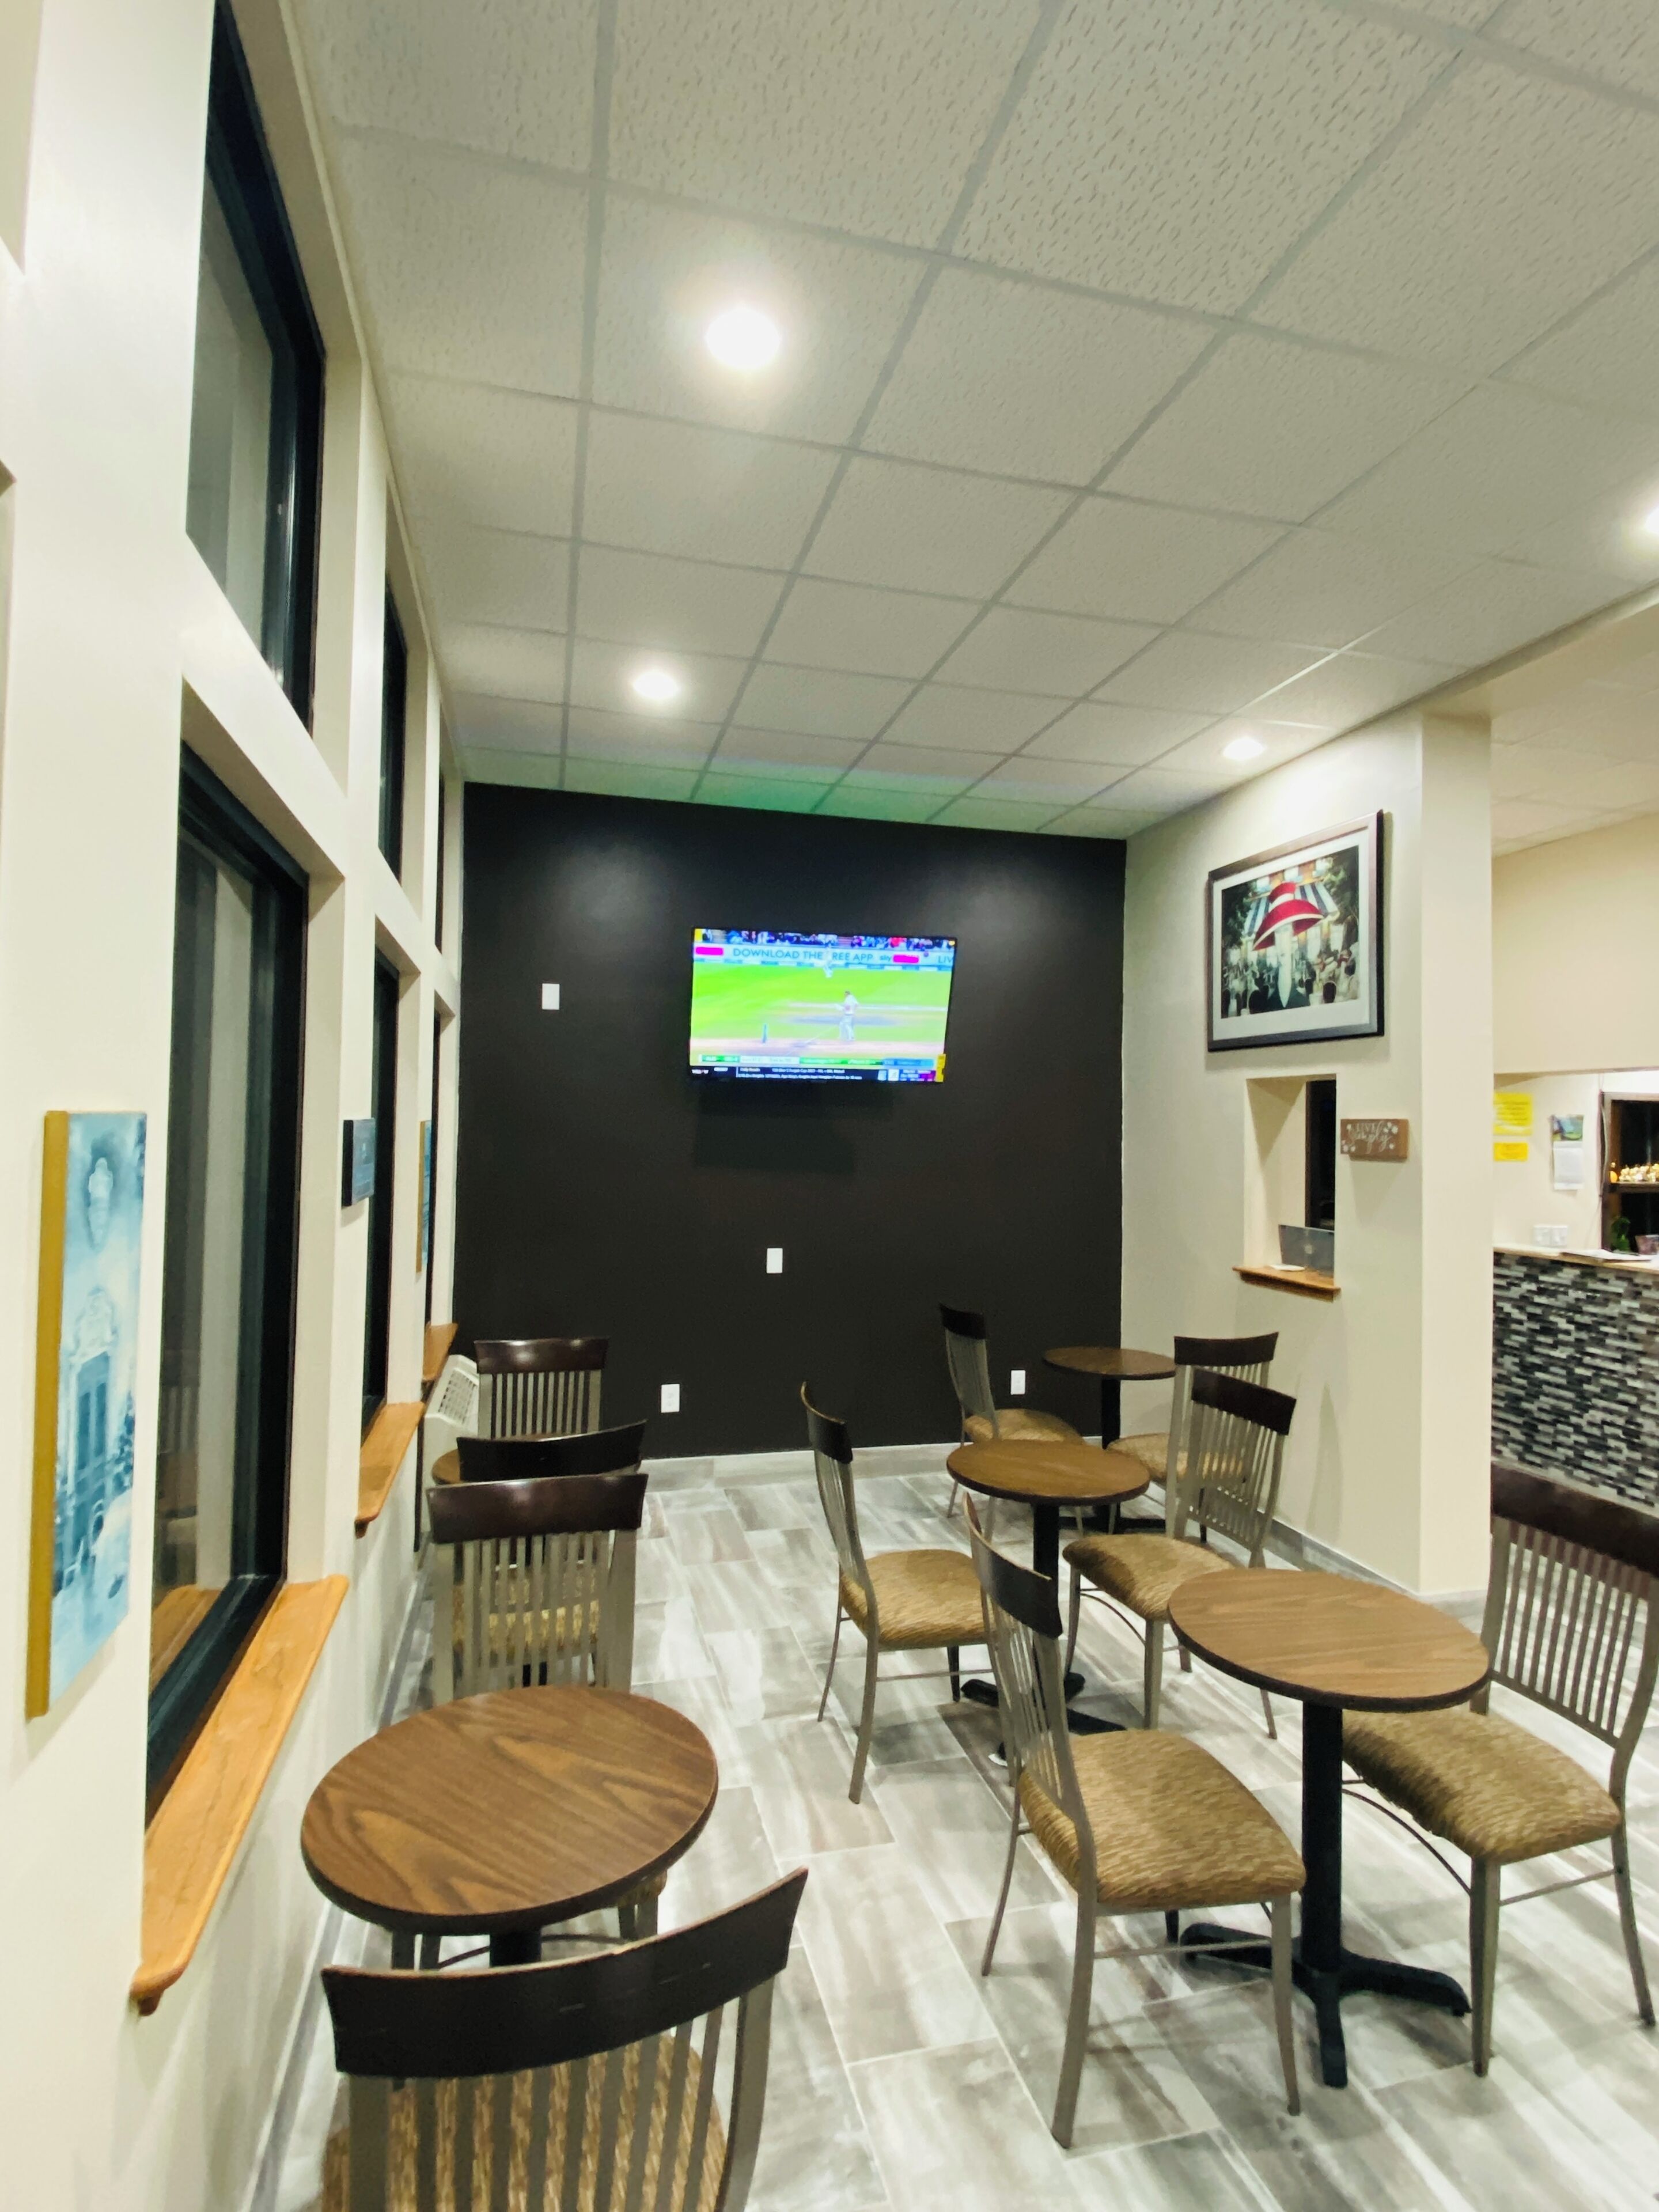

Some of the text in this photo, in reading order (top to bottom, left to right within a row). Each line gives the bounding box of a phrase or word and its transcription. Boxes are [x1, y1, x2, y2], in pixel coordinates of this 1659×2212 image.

[733, 948, 873, 961] DOWNLOAD THE REE APP
